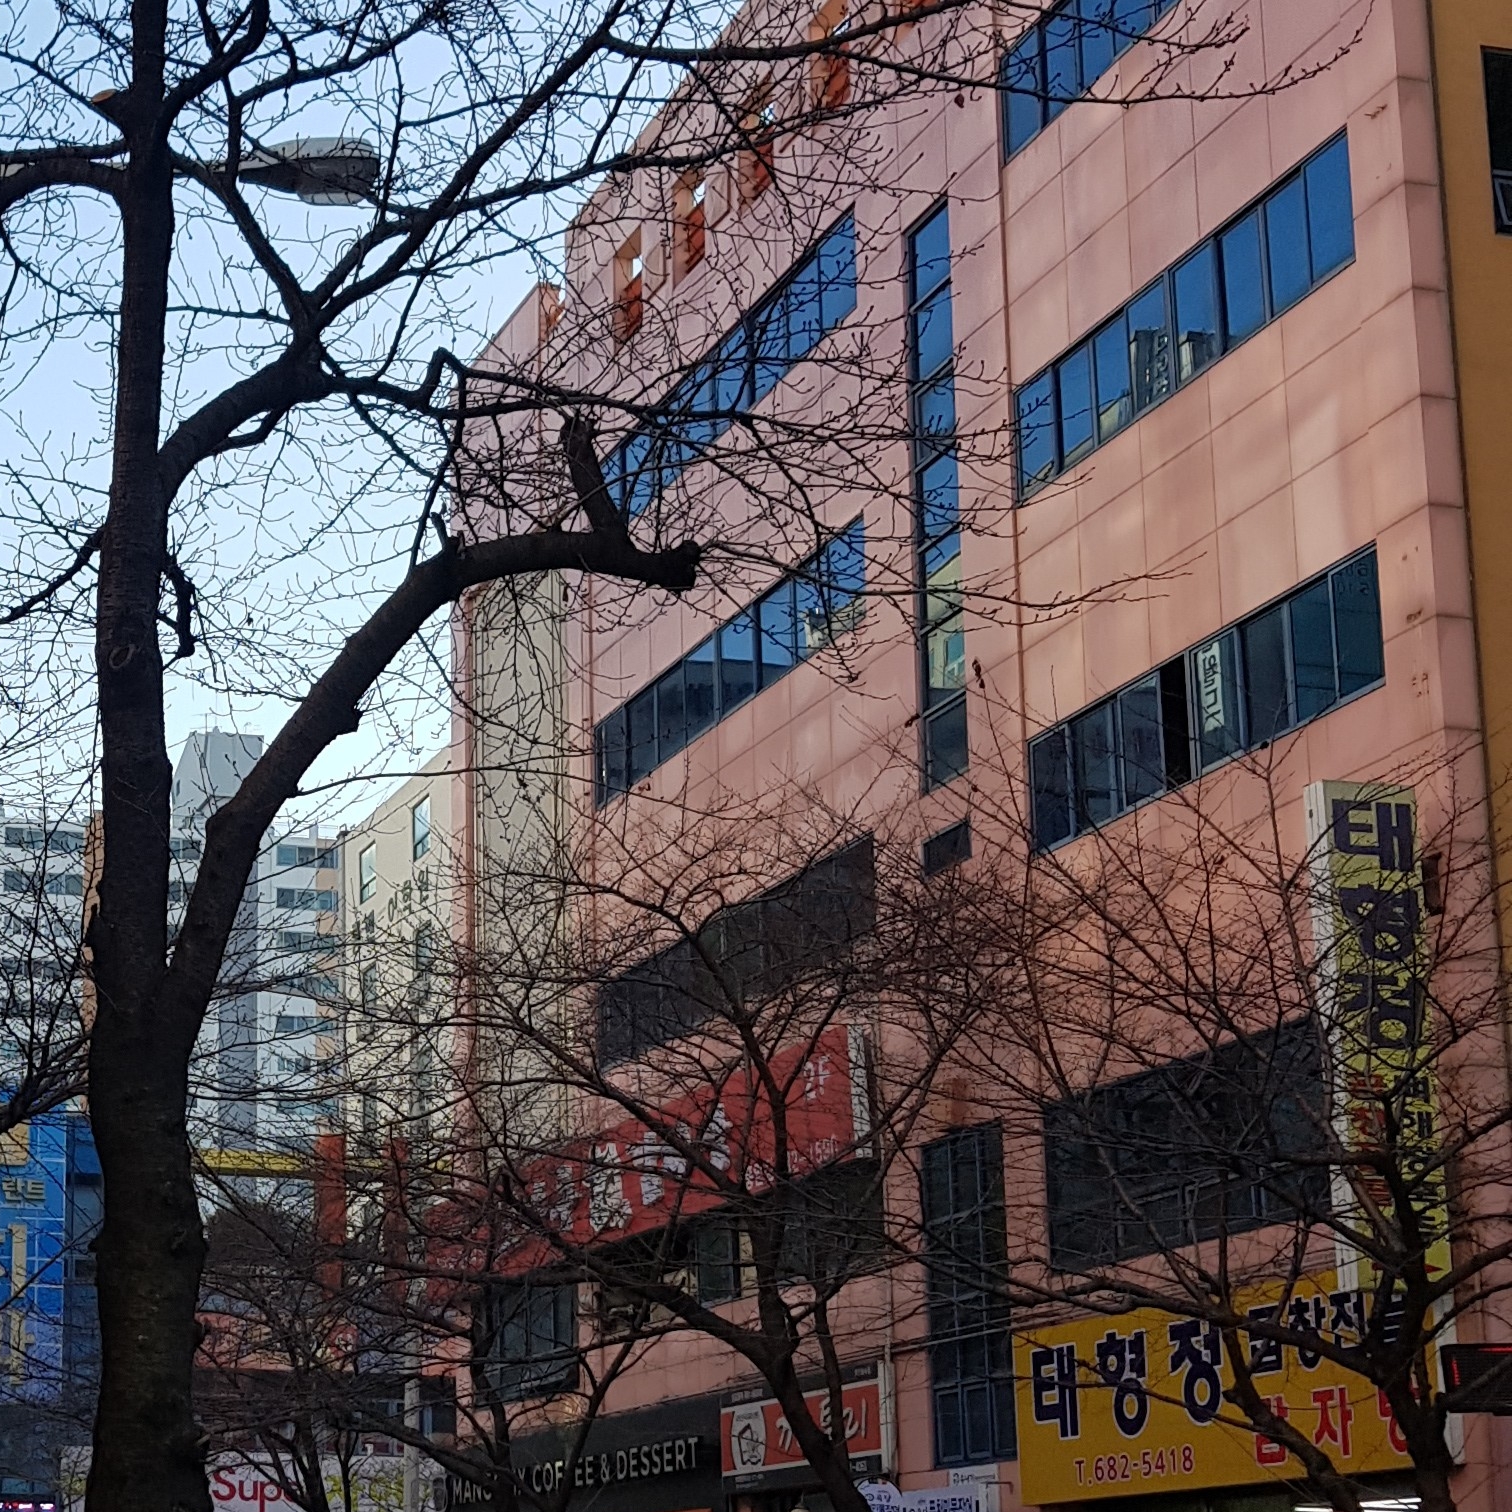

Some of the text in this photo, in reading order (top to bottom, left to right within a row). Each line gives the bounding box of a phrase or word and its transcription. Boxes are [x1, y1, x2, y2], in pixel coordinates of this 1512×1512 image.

[1031, 1320, 1226, 1440] 태형정
[600, 1453, 611, 1483] &
[616, 1436, 700, 1480] DESSERT
[1075, 1446, 1194, 1486] T.682-5418
